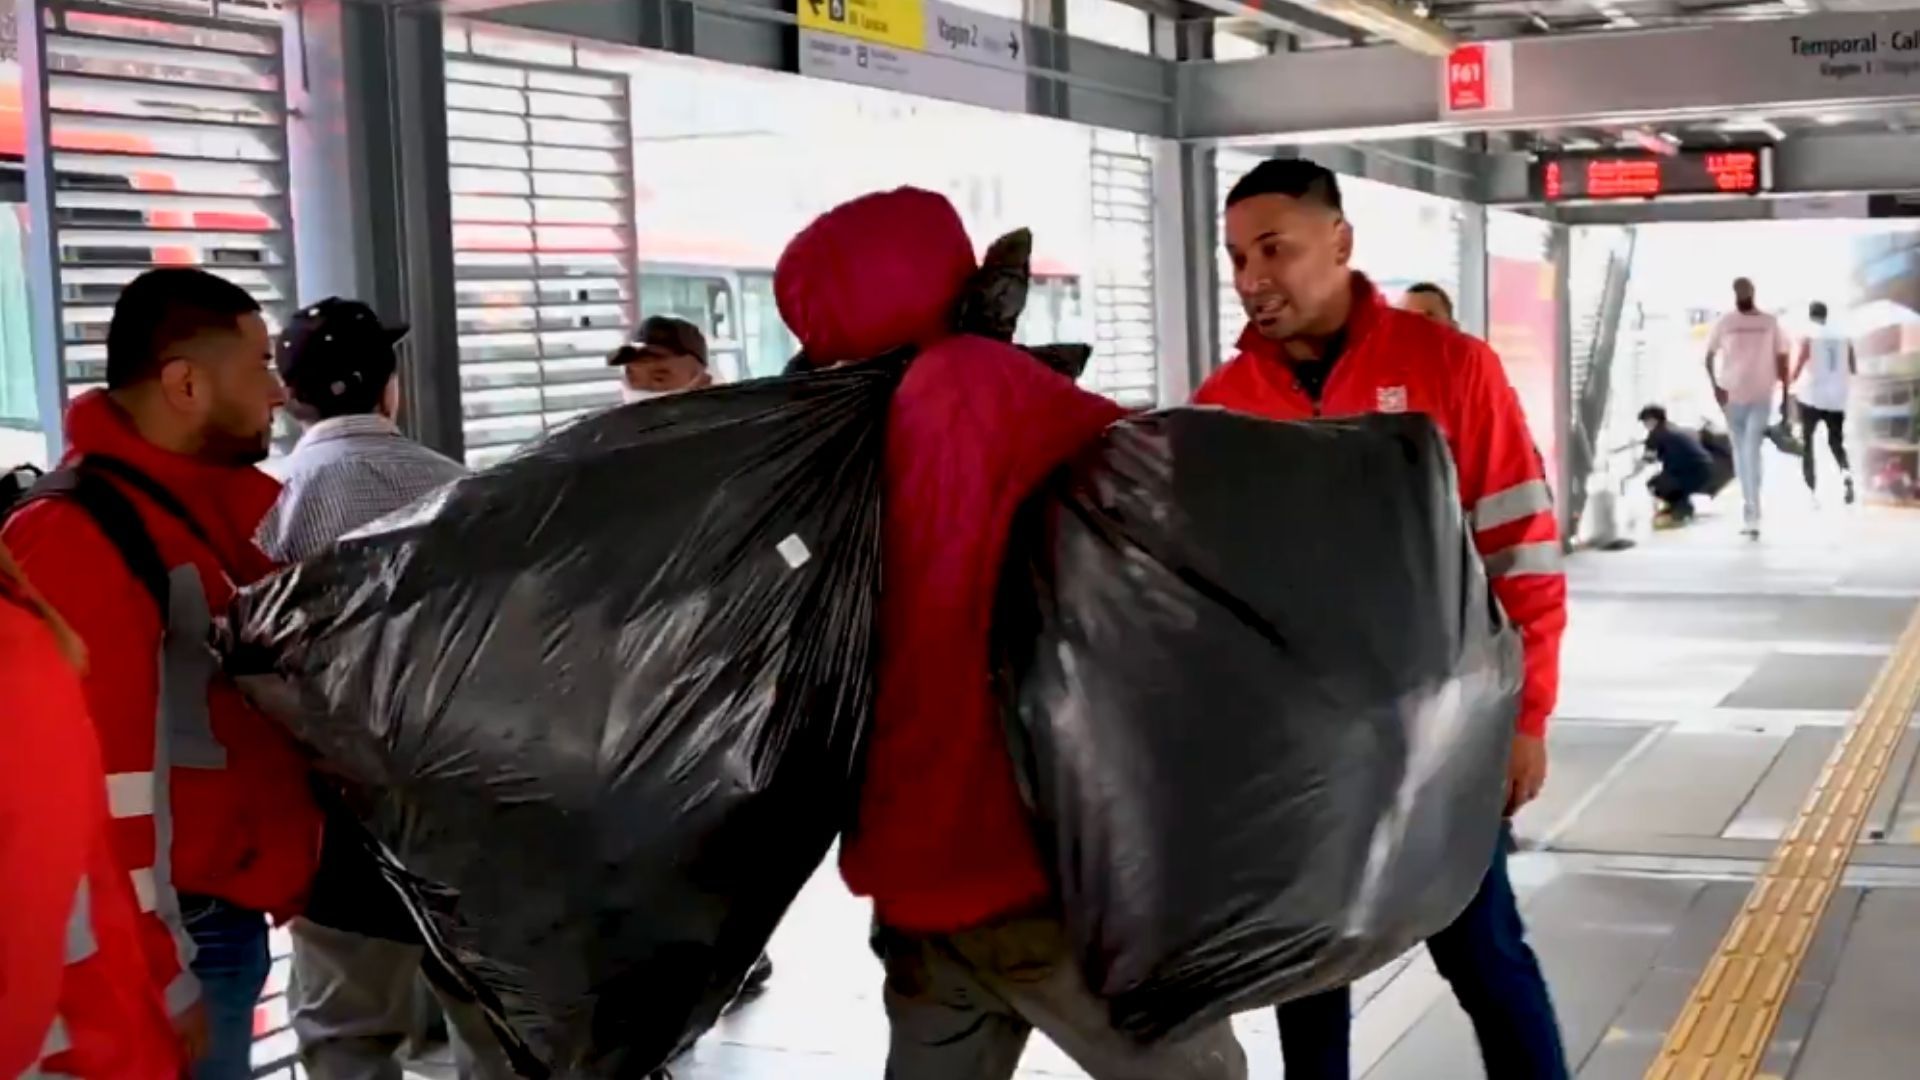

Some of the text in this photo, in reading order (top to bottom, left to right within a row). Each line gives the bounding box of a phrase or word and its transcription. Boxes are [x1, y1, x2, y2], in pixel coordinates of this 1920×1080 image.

[970, 24, 978, 47] 2
[1790, 31, 1877, 59] Temporal
[1891, 30, 1920, 51] Cal
